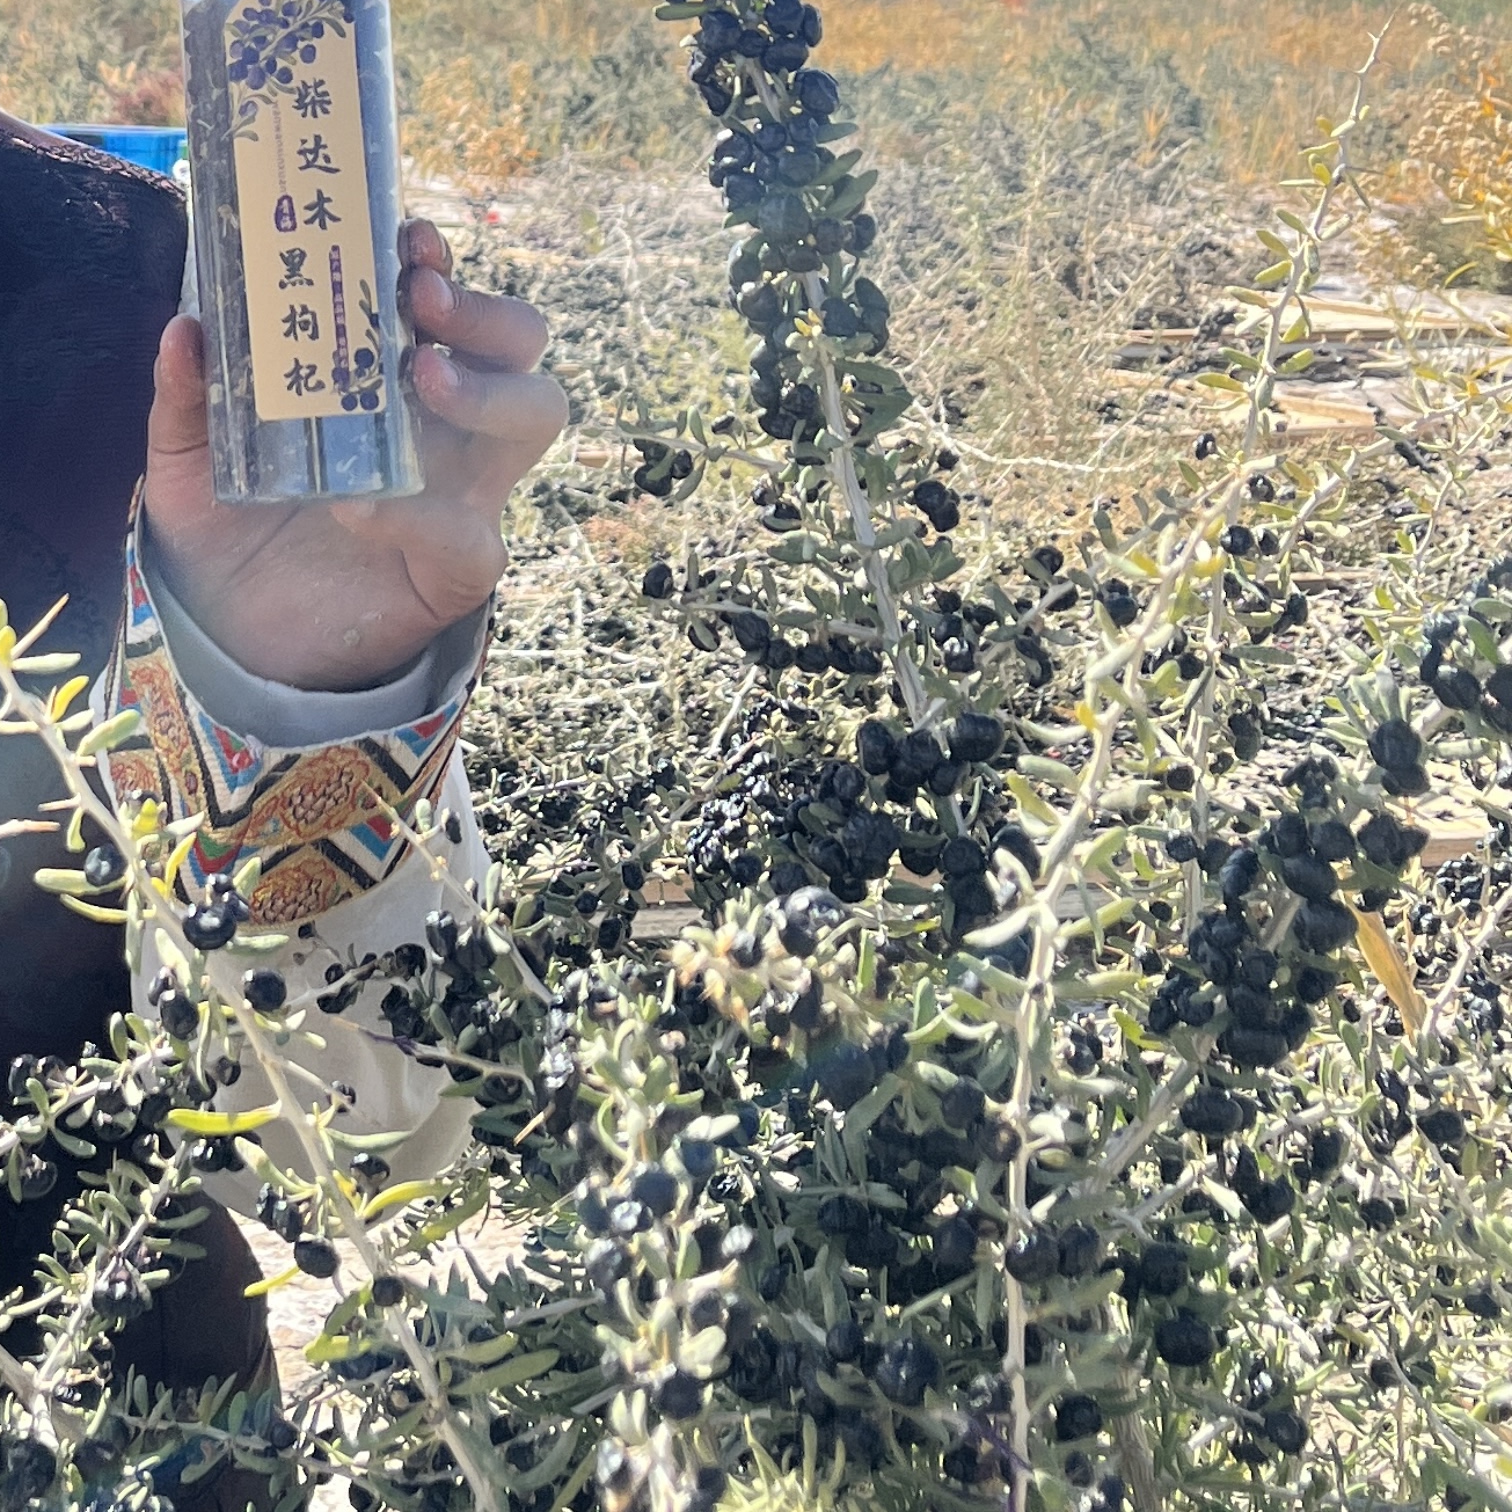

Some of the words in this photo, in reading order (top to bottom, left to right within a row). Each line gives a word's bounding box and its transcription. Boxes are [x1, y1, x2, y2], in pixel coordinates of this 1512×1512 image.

[292, 77, 341, 230] 柴达木
[278, 247, 326, 397] 黑枸杞
